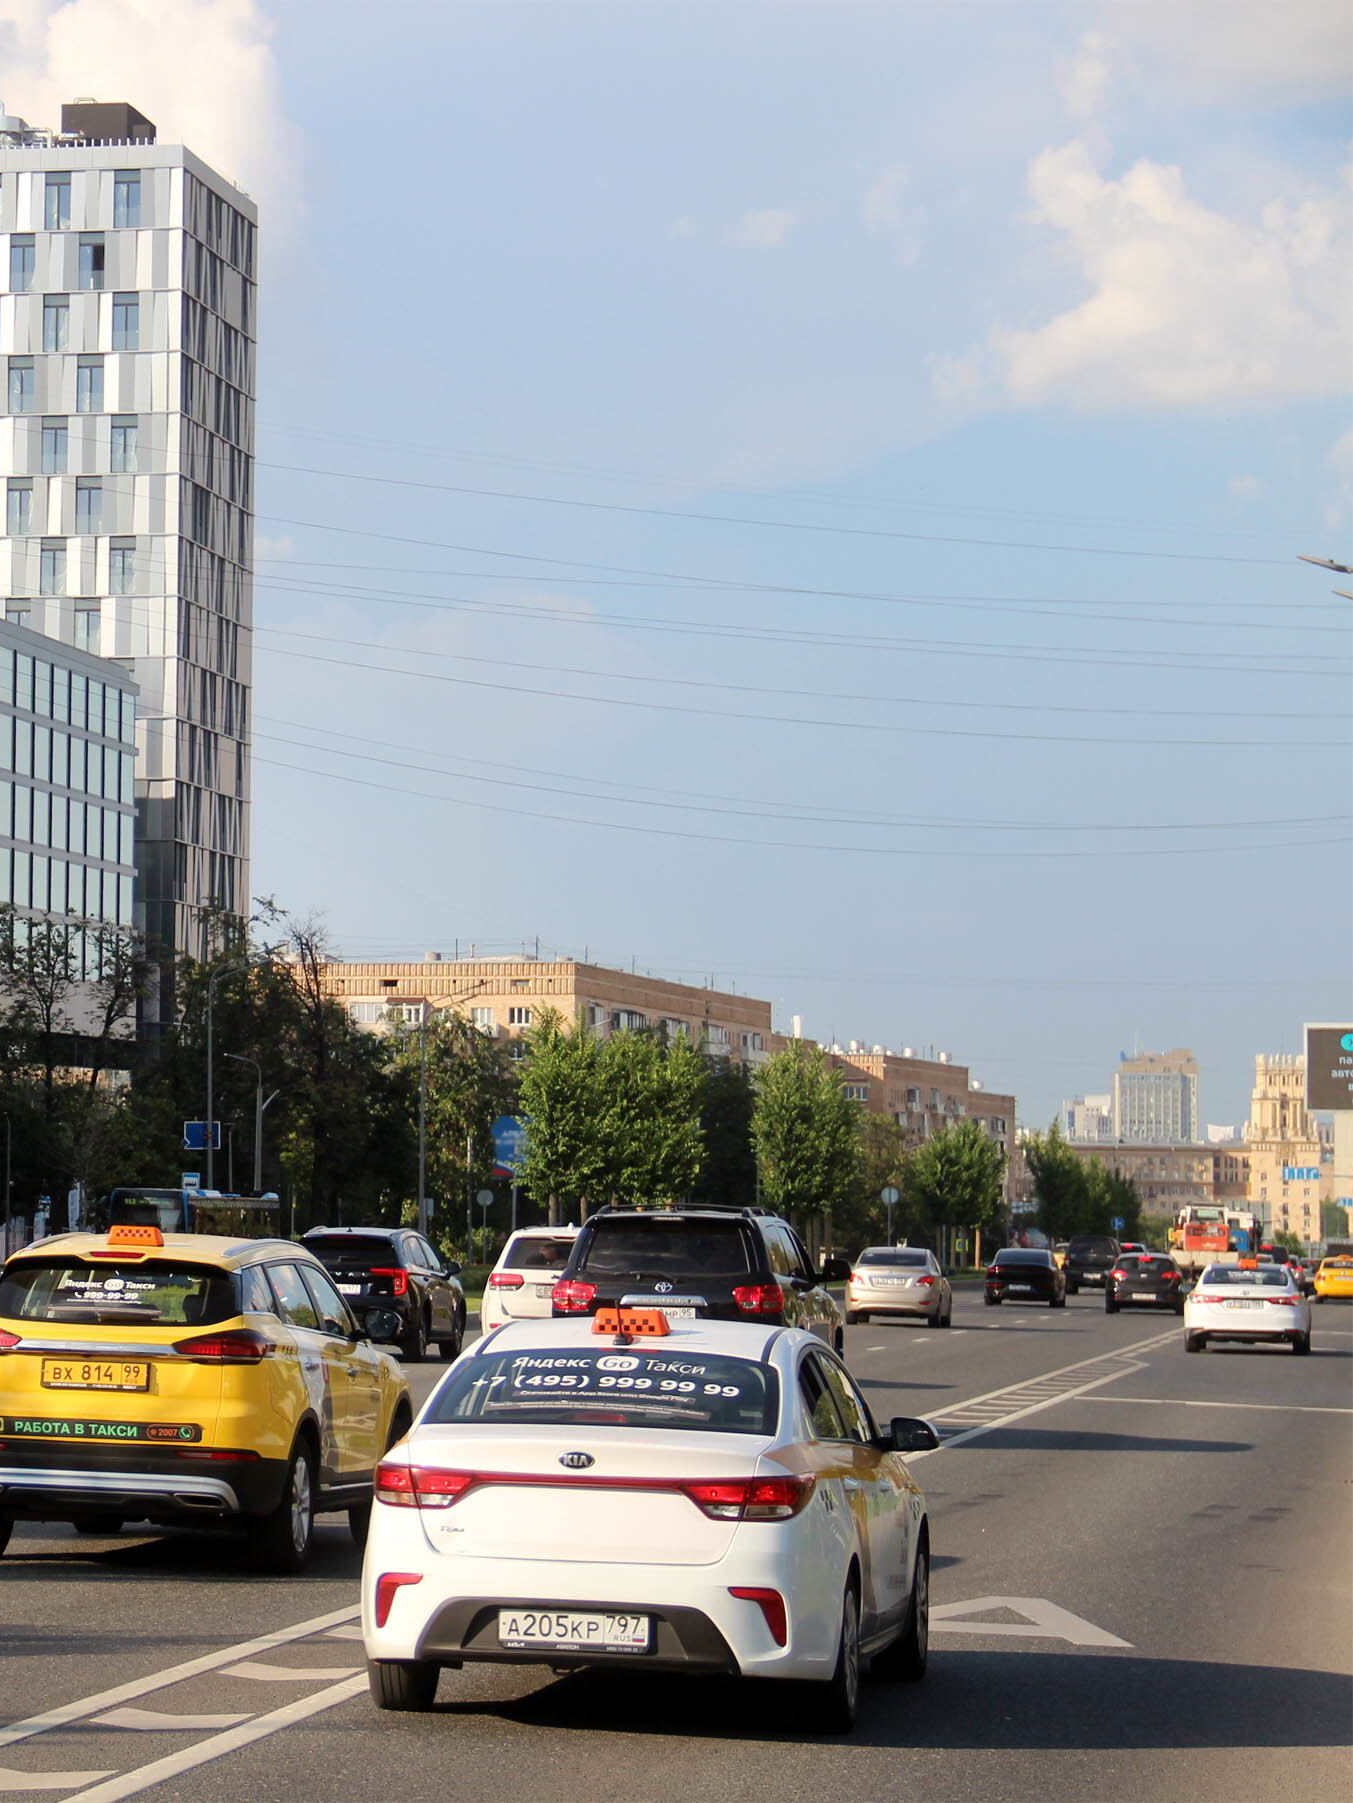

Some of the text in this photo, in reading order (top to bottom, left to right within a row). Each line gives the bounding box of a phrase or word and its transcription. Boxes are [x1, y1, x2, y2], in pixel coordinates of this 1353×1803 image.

[64, 1279, 103, 1290] Яндекс
[126, 1281, 156, 1290] Такси
[83, 1291, 139, 1300] 999-99-99
[53, 1364, 140, 1381] ВХ 814 99
[511, 1356, 592, 1369] Яндекс
[645, 1359, 707, 1375] Такси
[472, 1375, 740, 1398] +7 (495) 999 99 99
[14, 1421, 70, 1435] РАБОТА
[75, 1424, 84, 1435] В
[89, 1424, 138, 1437] ТАКСИ
[562, 1454, 589, 1465] KIA
[507, 1613, 641, 1639] А205КР 797
[613, 1634, 632, 1642] RUS
